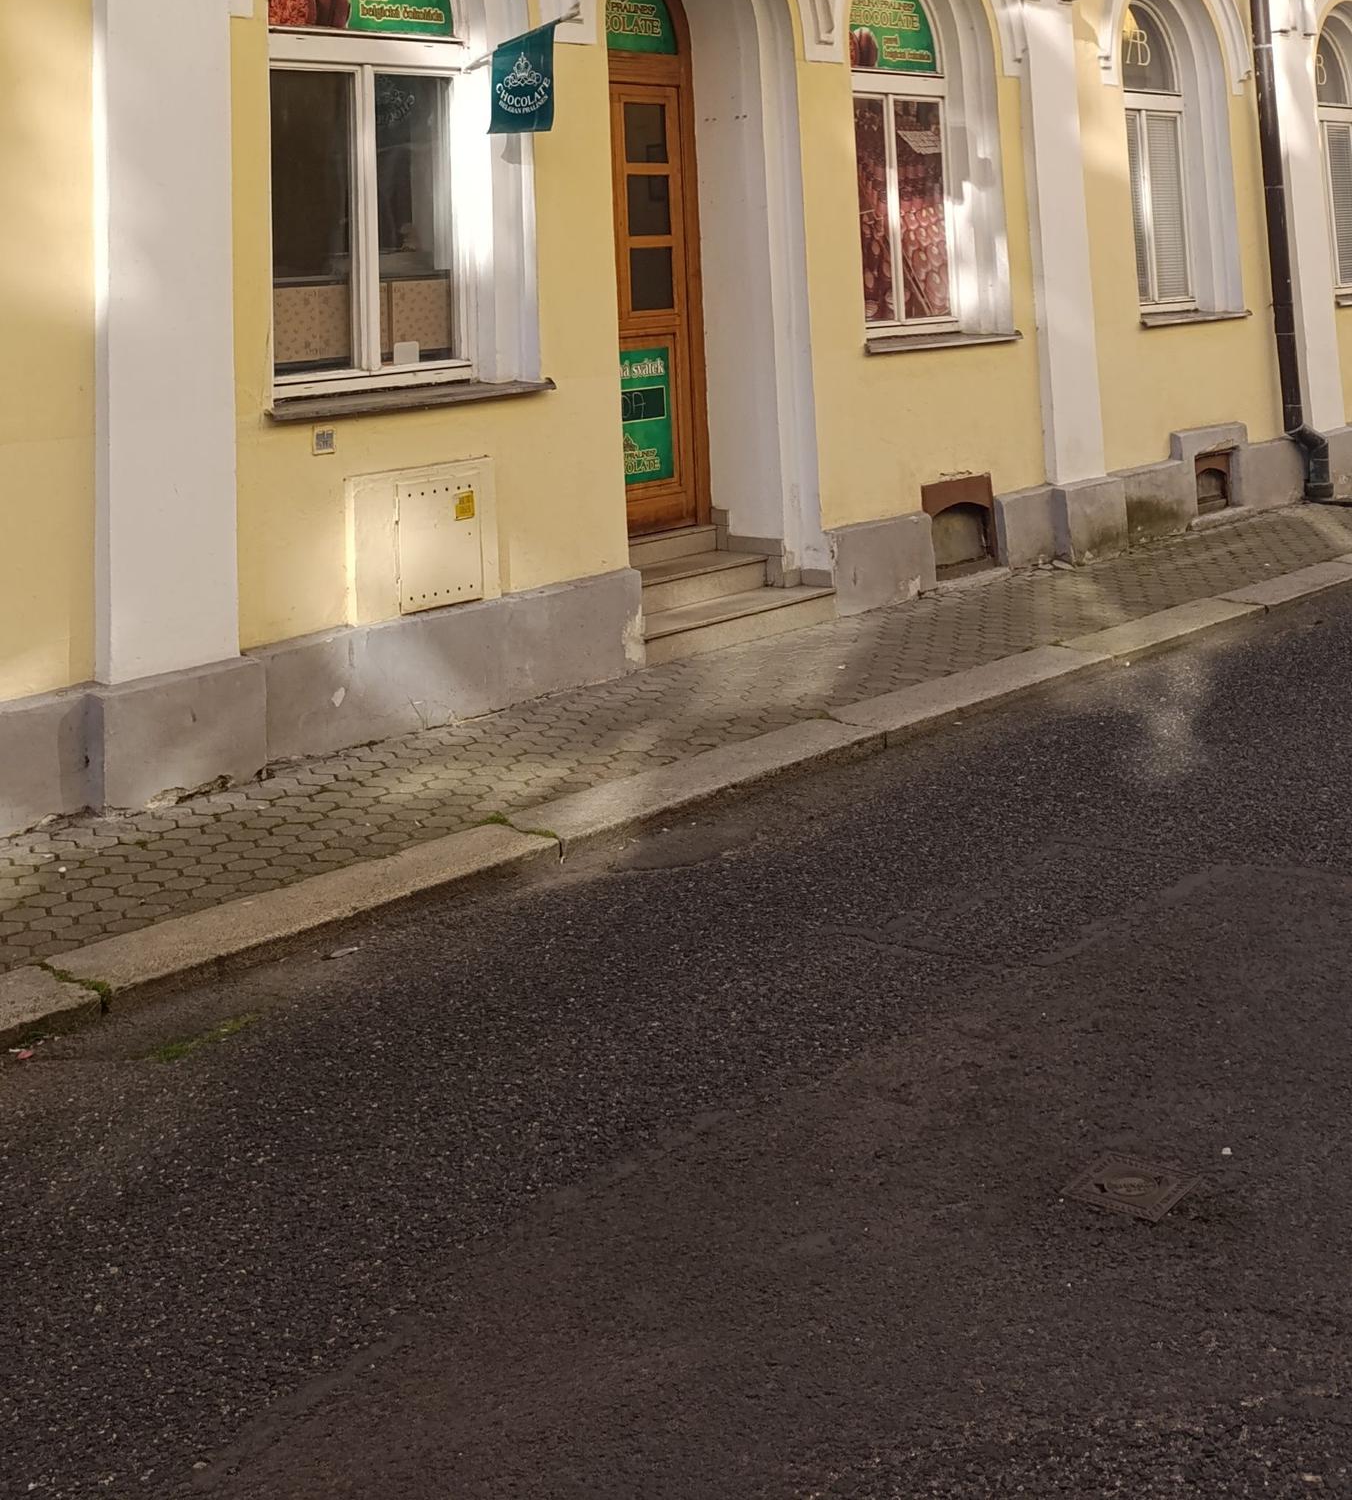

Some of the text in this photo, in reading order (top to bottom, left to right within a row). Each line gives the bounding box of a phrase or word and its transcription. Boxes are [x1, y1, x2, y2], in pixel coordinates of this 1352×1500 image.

[850, 9, 919, 29] HOCOLATE
[1316, 53, 1327, 85] B
[496, 78, 550, 107] CHOCOLATE
[632, 360, 664, 377] svátek
